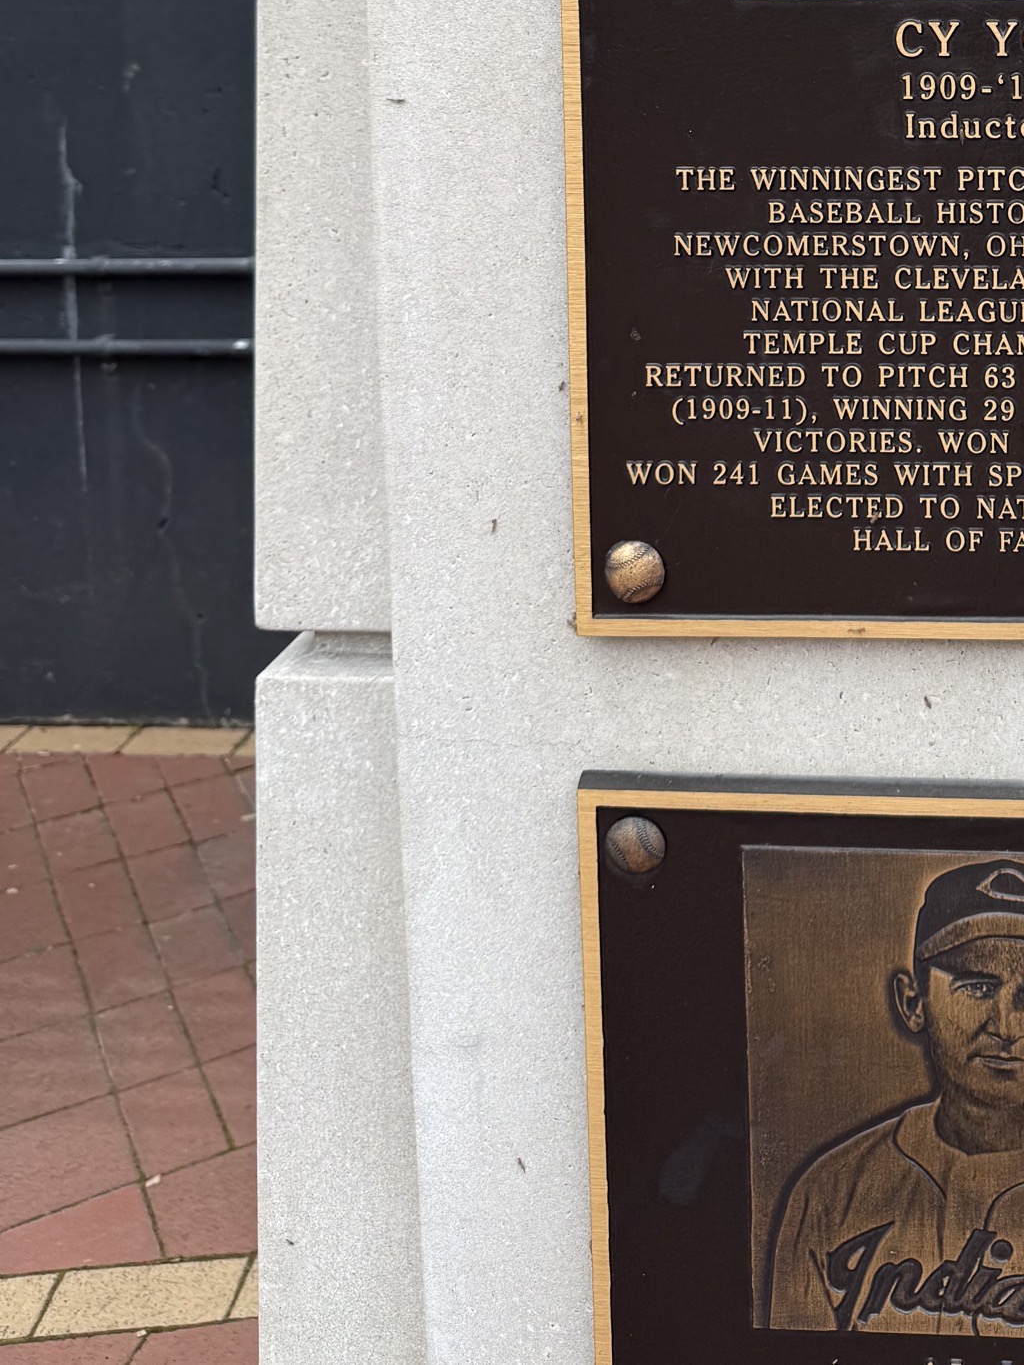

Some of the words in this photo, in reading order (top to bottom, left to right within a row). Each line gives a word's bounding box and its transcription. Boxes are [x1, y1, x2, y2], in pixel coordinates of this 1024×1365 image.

[895, 21, 959, 58] CY
[675, 168, 735, 191] THE
[750, 168, 942, 191] WINNINGEST
[768, 201, 921, 224] BASEBALL
[674, 234, 969, 260] NEWCOMERSTOWN,
[725, 267, 803, 289] WITH
[819, 267, 879, 290] THE
[751, 299, 904, 322] NATIONAL
[743, 332, 863, 355] TEMPLE
[878, 333, 937, 355] CUP
[645, 365, 806, 387] RETURNED
[821, 365, 862, 388] TO
[878, 365, 967, 389] PITCH
[984, 366, 1015, 389] 63
[671, 398, 817, 426] (1909-11),
[832, 398, 967, 421] WINNING
[983, 399, 1015, 422] 29
[753, 430, 922, 454] VICTORIES.
[938, 431, 1009, 454] WON
[626, 462, 696, 485] WON
[713, 462, 757, 485] 241
[777, 463, 878, 486] GAMES
[893, 464, 972, 487] WITH
[770, 496, 904, 520] ELECTED
[919, 496, 960, 520] TO
[853, 529, 929, 552] HALL
[945, 529, 984, 552] OF
